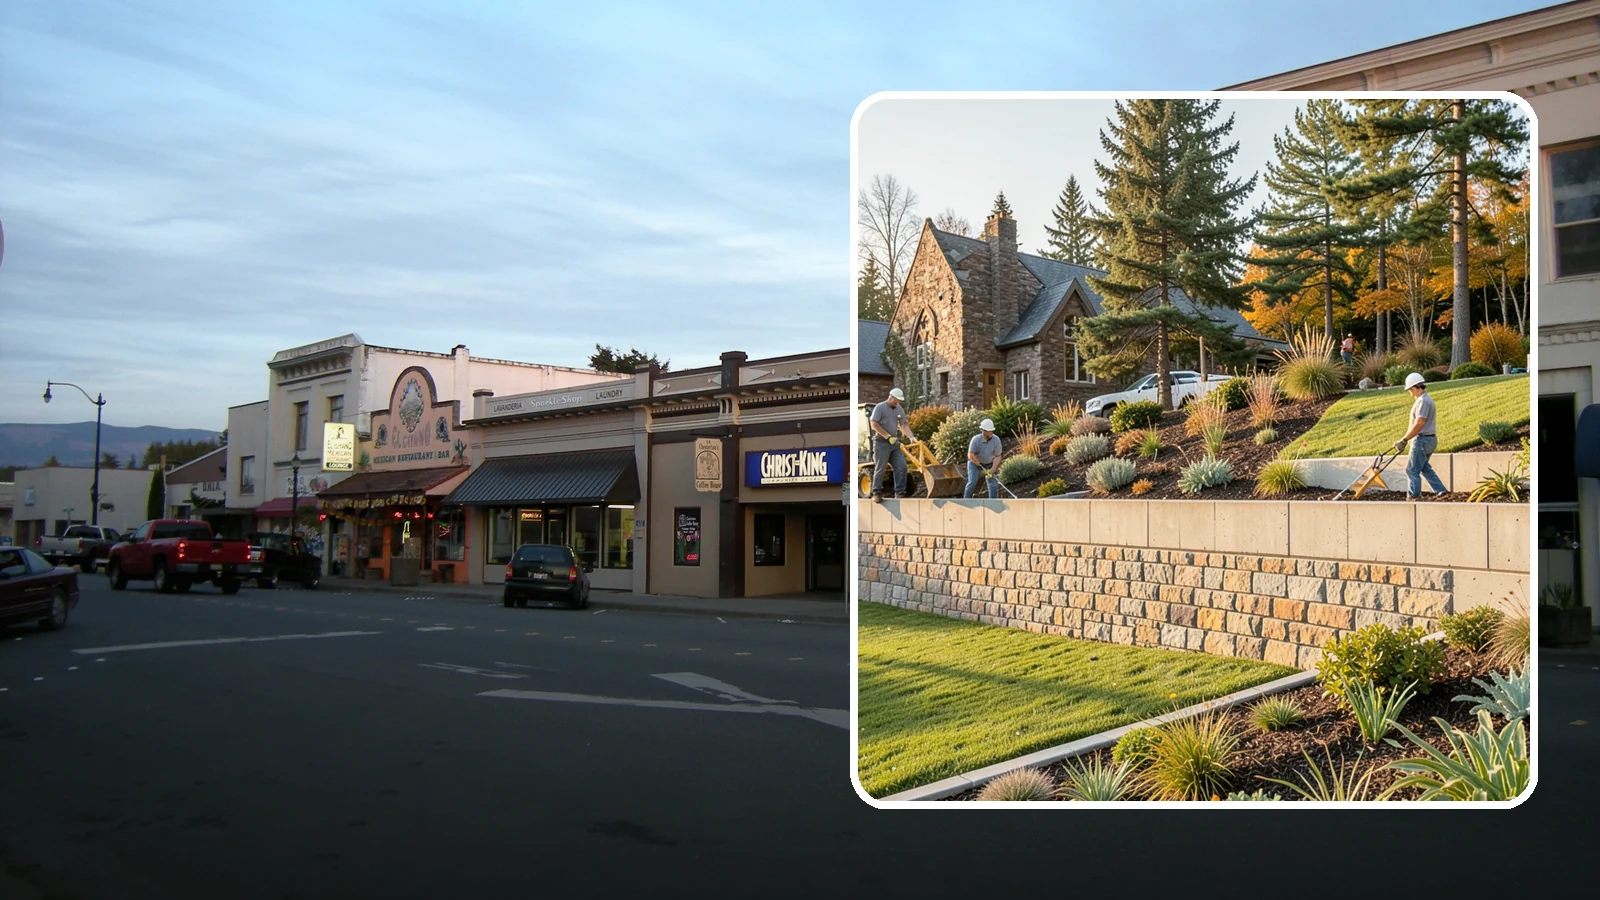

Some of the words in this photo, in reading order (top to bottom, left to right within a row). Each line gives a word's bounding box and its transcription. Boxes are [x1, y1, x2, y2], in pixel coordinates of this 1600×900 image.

[493, 402, 523, 413] LAVANDERIA
[561, 394, 583, 404] Shop
[595, 389, 623, 400] LAUNDRY
[374, 455, 396, 464] MEXICAN
[397, 451, 433, 462] RESTAURANT
[437, 450, 450, 459] BAR
[760, 452, 797, 478] CHRIST
[799, 450, 827, 476] KING
